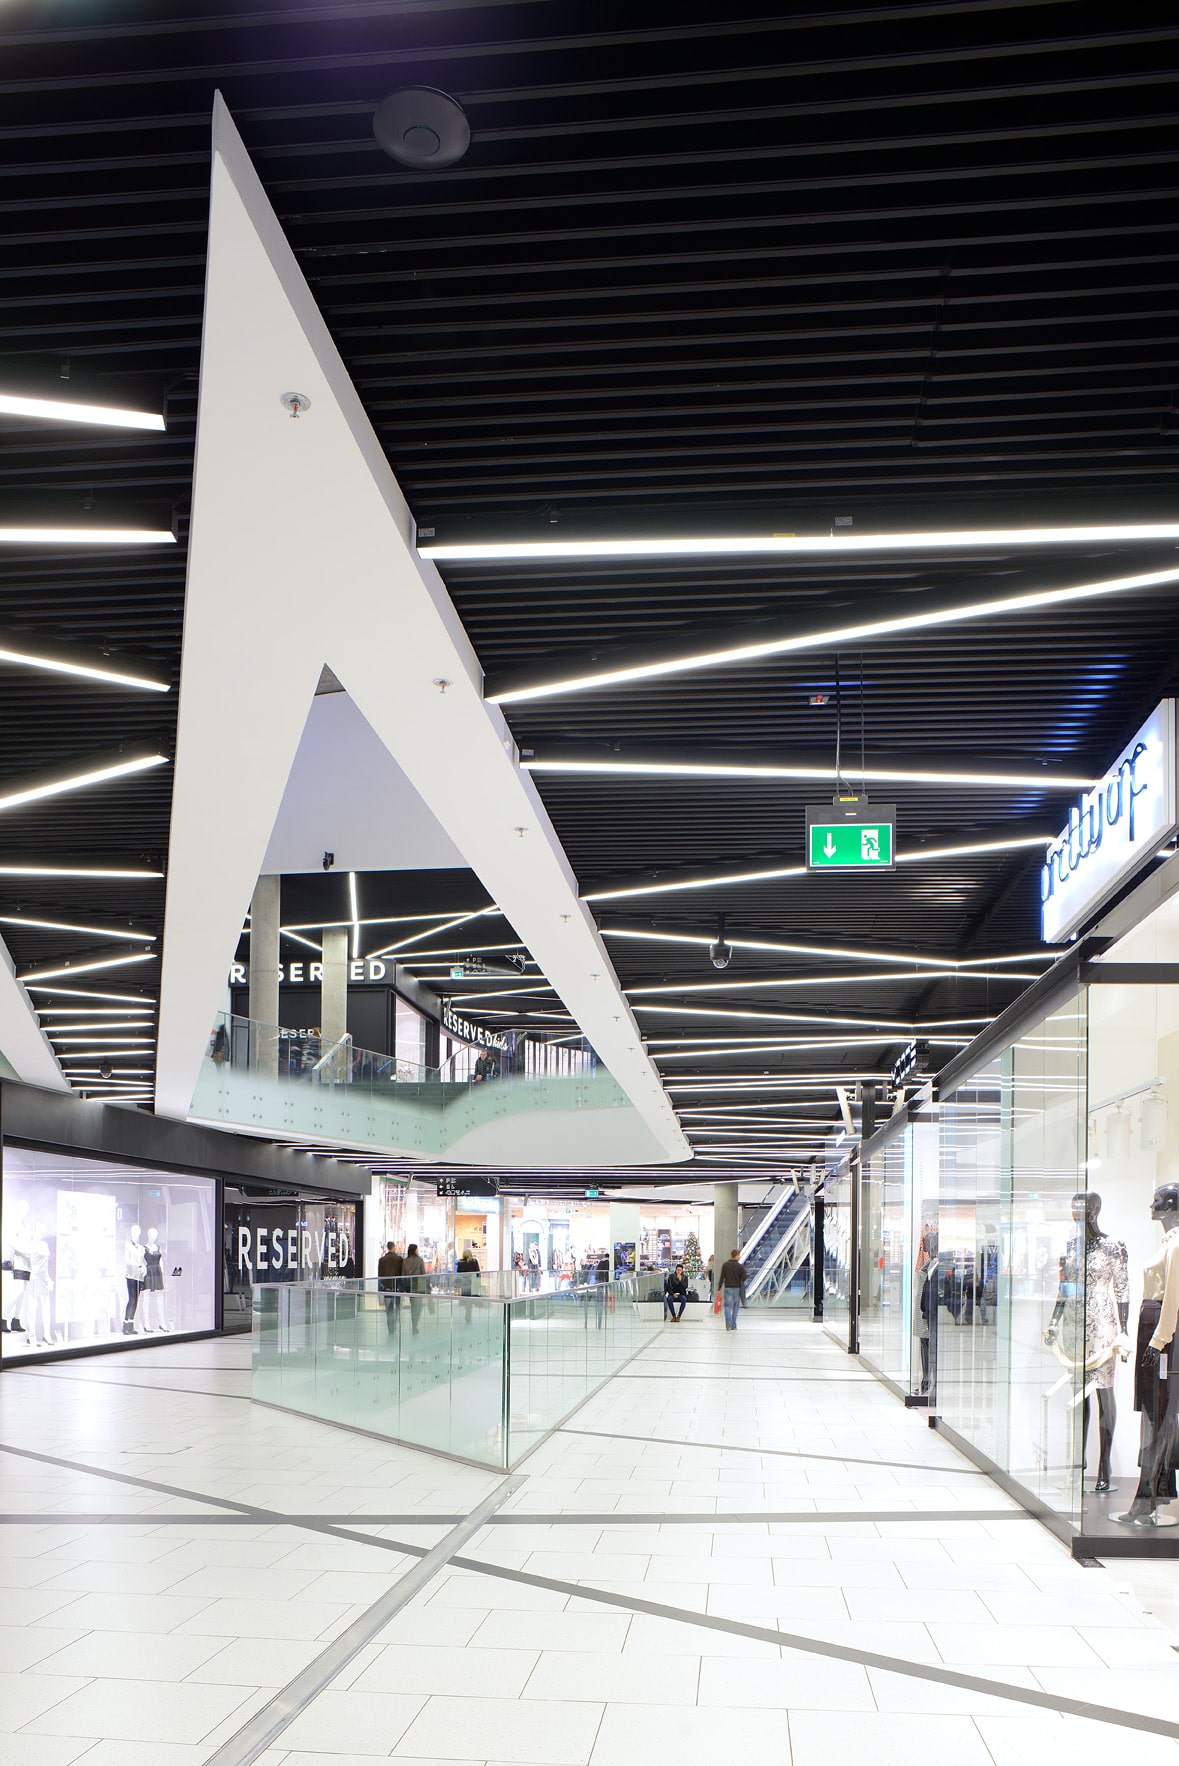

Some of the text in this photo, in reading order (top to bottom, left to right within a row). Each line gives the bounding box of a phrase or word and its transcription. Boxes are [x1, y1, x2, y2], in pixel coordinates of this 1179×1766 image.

[230, 961, 386, 984] RSERED
[443, 1007, 492, 1047] RESERVED
[238, 1226, 349, 1270] RESERVED
